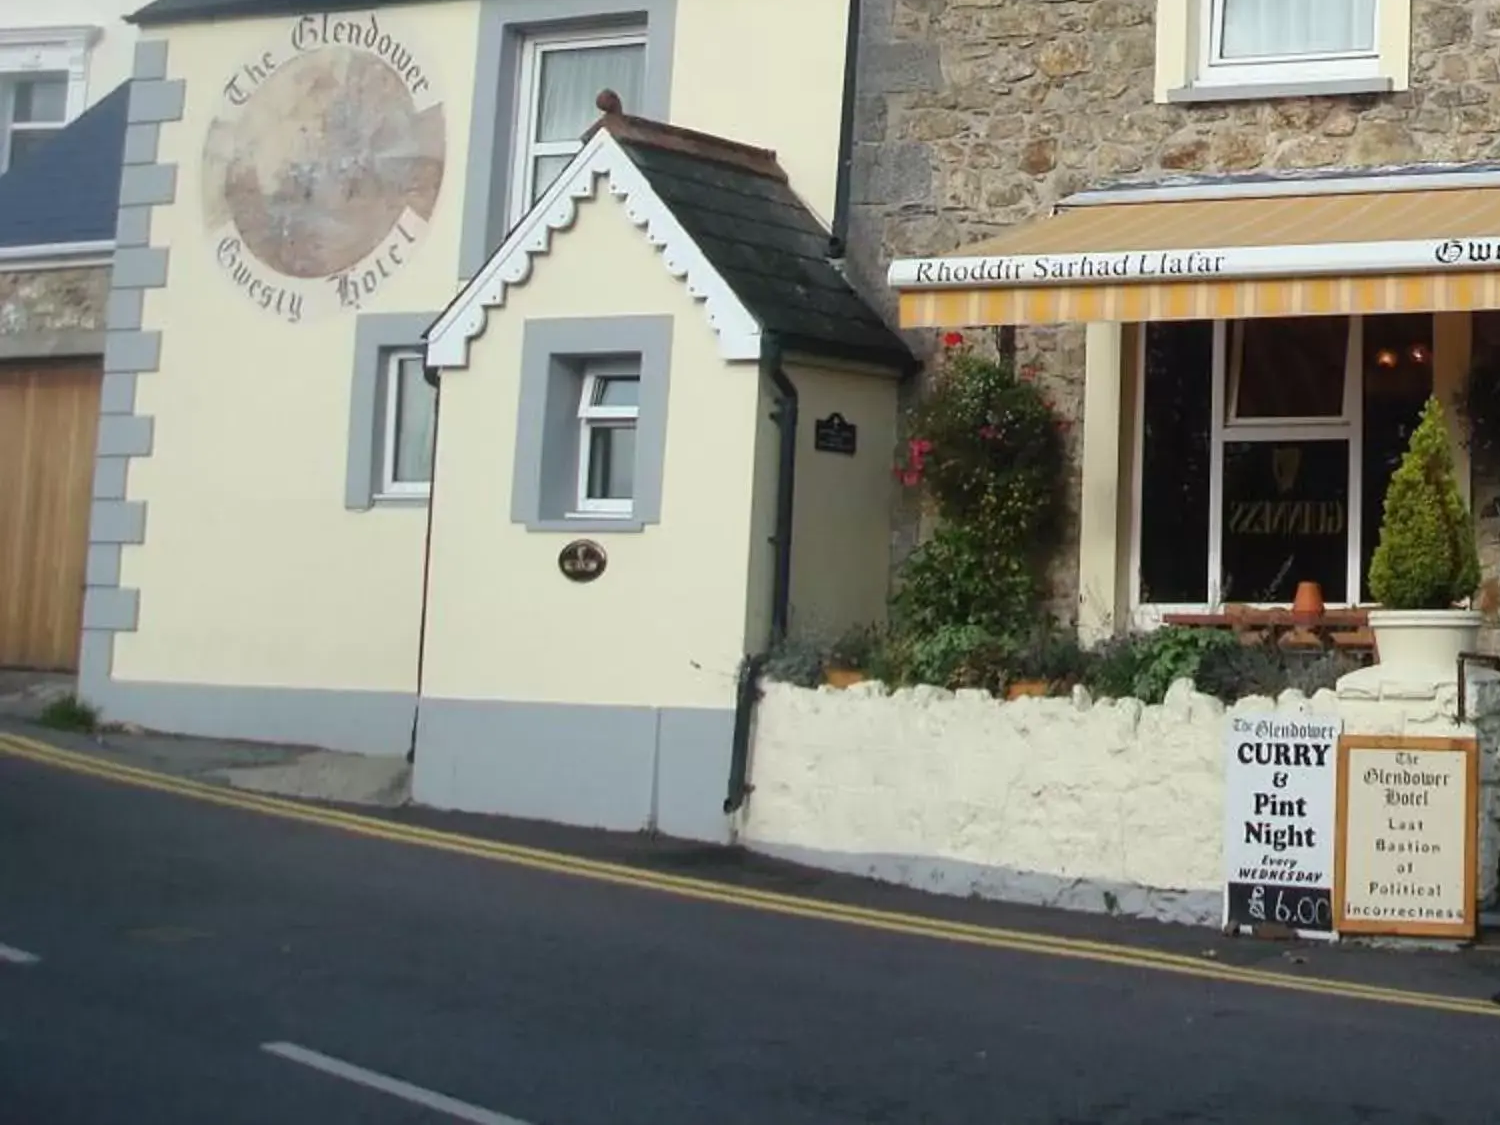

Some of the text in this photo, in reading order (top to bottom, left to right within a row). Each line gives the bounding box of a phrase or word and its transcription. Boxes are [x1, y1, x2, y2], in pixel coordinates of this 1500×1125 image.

[223, 12, 428, 106] The Glendower
[217, 224, 416, 322] Gwesty Hotel
[916, 253, 1225, 283] Rhoddir Sarhad Llafar
[1256, 720, 1334, 740] Glendower
[1237, 743, 1331, 767] CURRY
[1394, 753, 1420, 765] The
[1272, 771, 1288, 788] &
[1363, 768, 1449, 787] Glendower
[1253, 793, 1308, 817] Pint
[1385, 788, 1429, 806] Hotel
[1387, 818, 1424, 831] Last
[1244, 821, 1316, 852] Night
[1375, 838, 1441, 854] Bastion
[1261, 855, 1298, 869] Every
[1396, 862, 1413, 874] of
[1239, 868, 1323, 883] WEDNESDAY
[1368, 881, 1441, 897] Political
